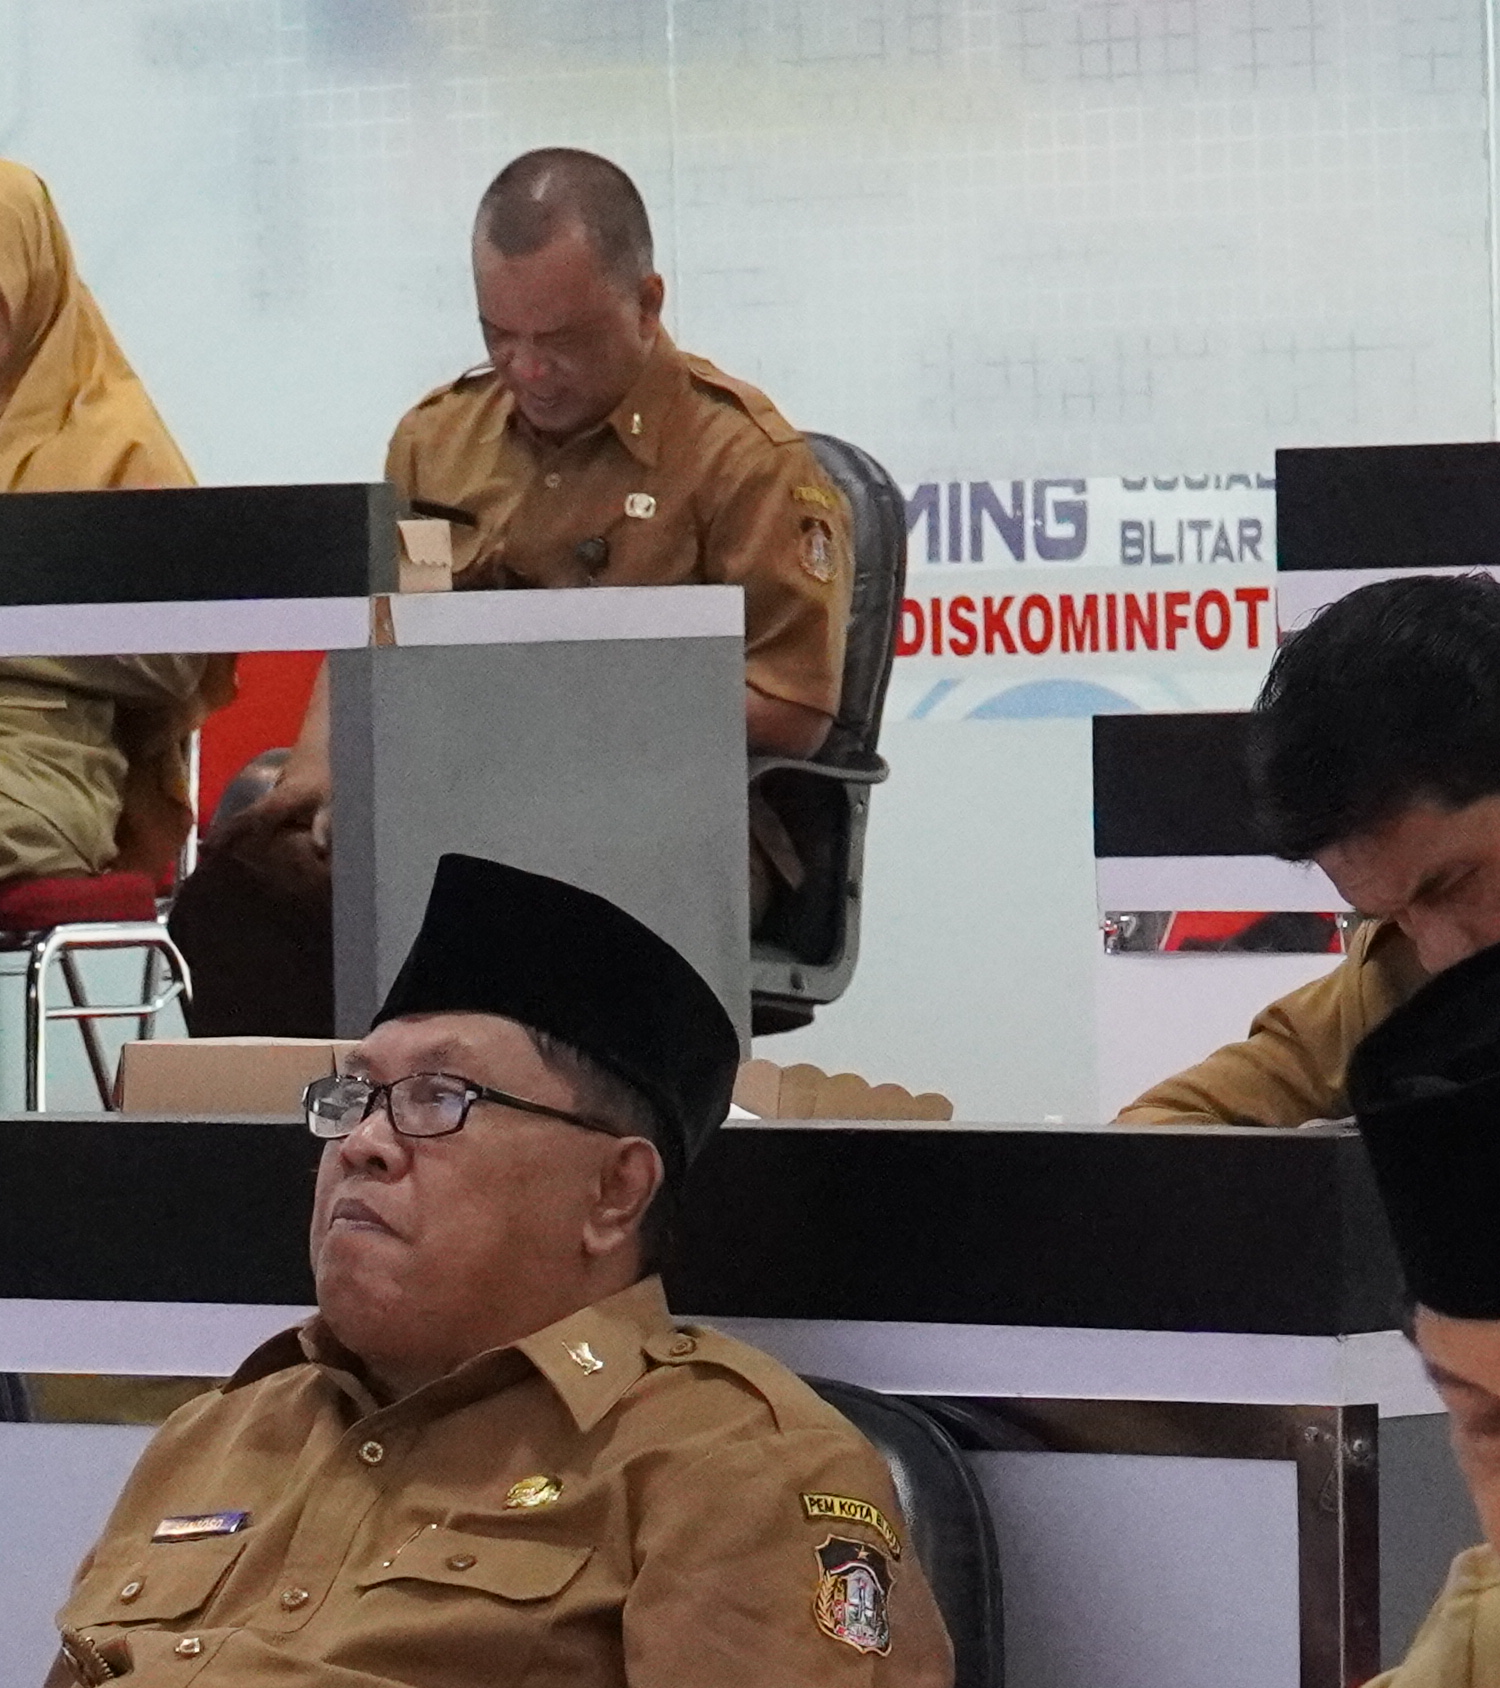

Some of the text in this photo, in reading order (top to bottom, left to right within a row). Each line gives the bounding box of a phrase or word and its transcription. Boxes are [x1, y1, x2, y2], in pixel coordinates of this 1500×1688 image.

[1120, 518, 1263, 566] BLITAR
[895, 586, 1279, 658] DISKOMINFOT
[808, 1497, 873, 1523] PEM KOTA
